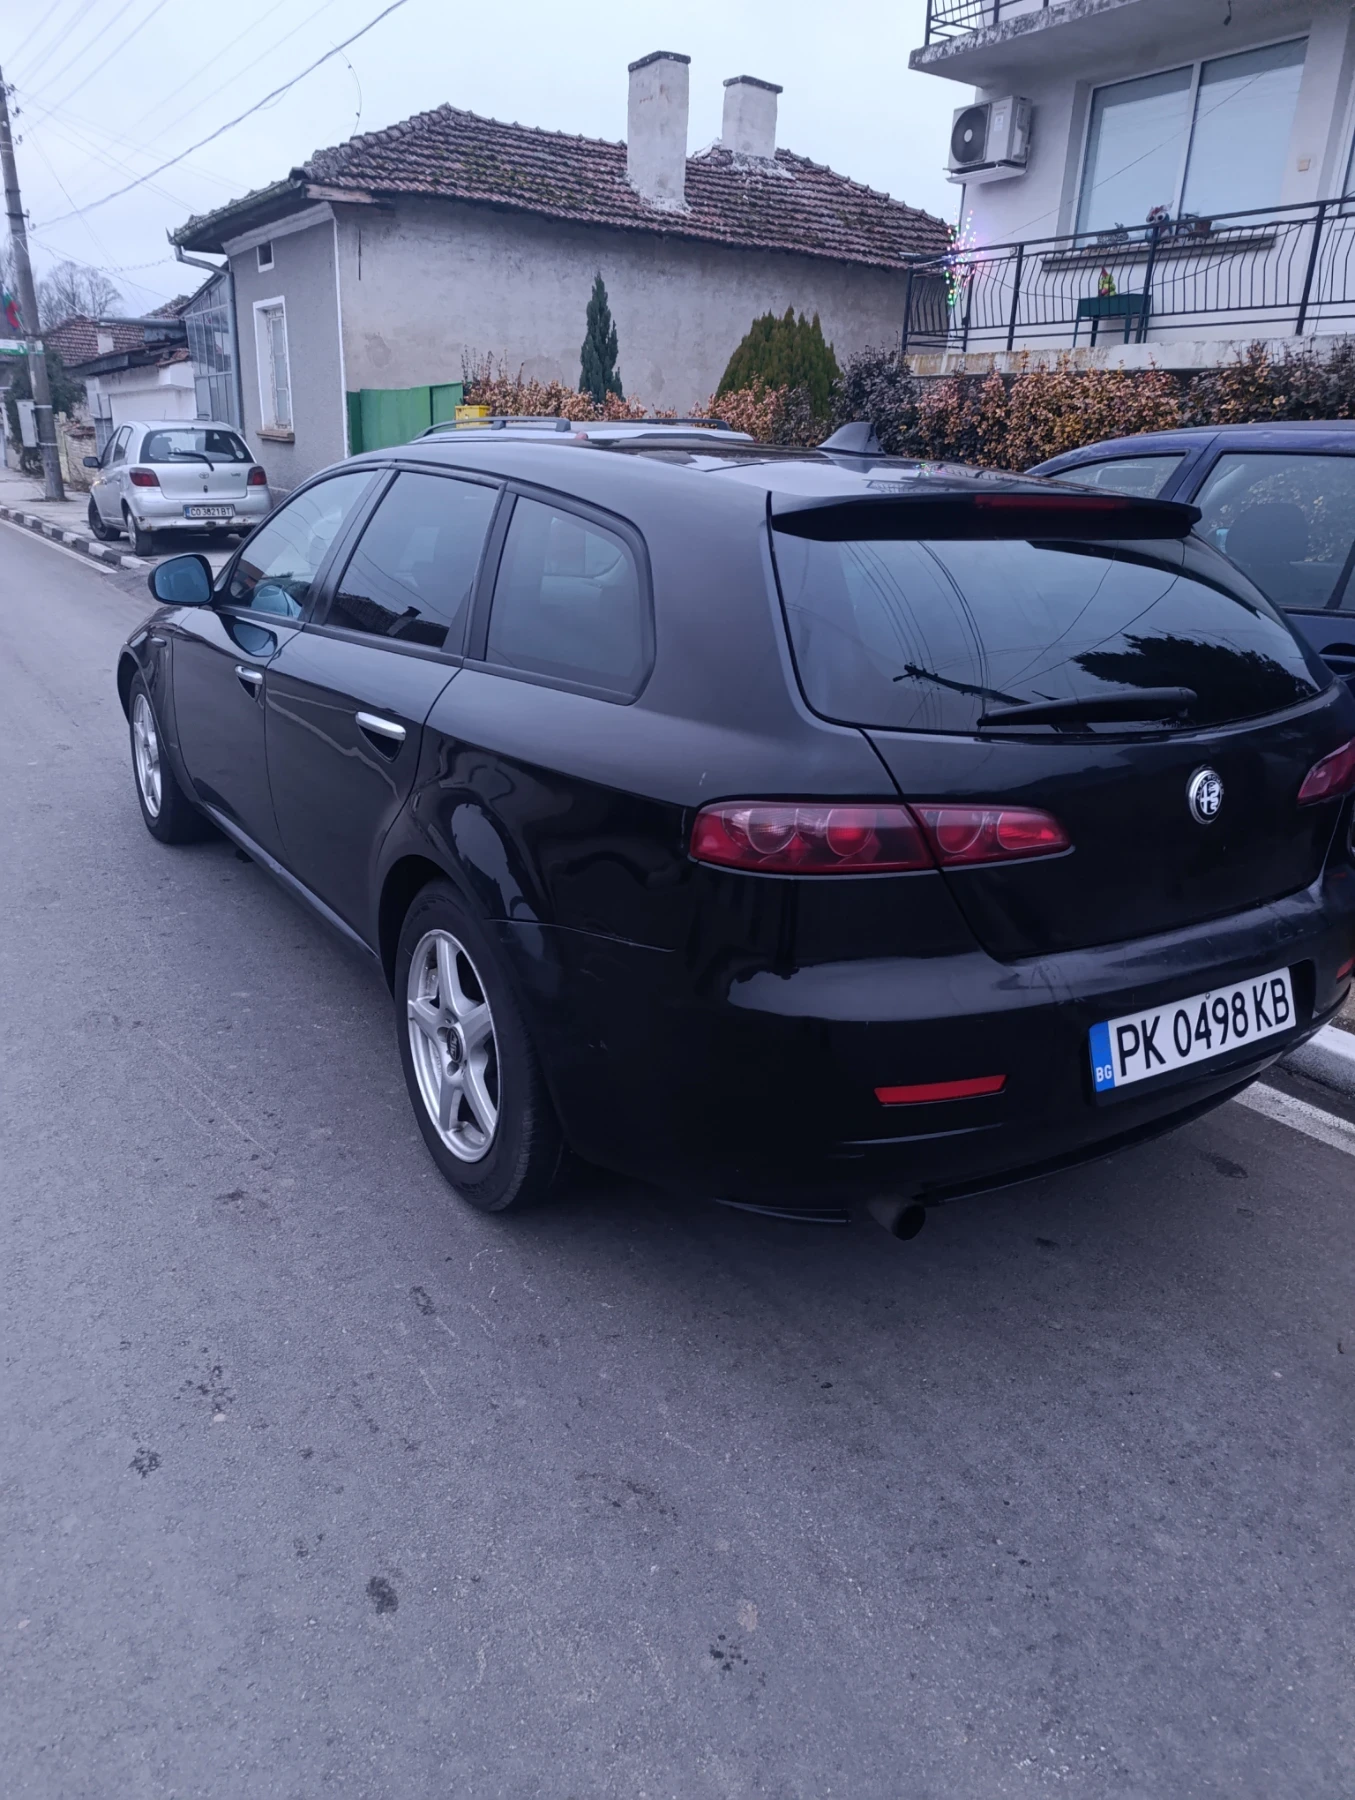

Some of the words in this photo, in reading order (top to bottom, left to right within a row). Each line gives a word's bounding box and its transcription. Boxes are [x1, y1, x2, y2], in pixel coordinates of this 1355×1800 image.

[1116, 1015, 1166, 1077] PK
[1173, 991, 1249, 1058] 0498
[1252, 977, 1290, 1032] KB
[1095, 1064, 1113, 1082] BG
